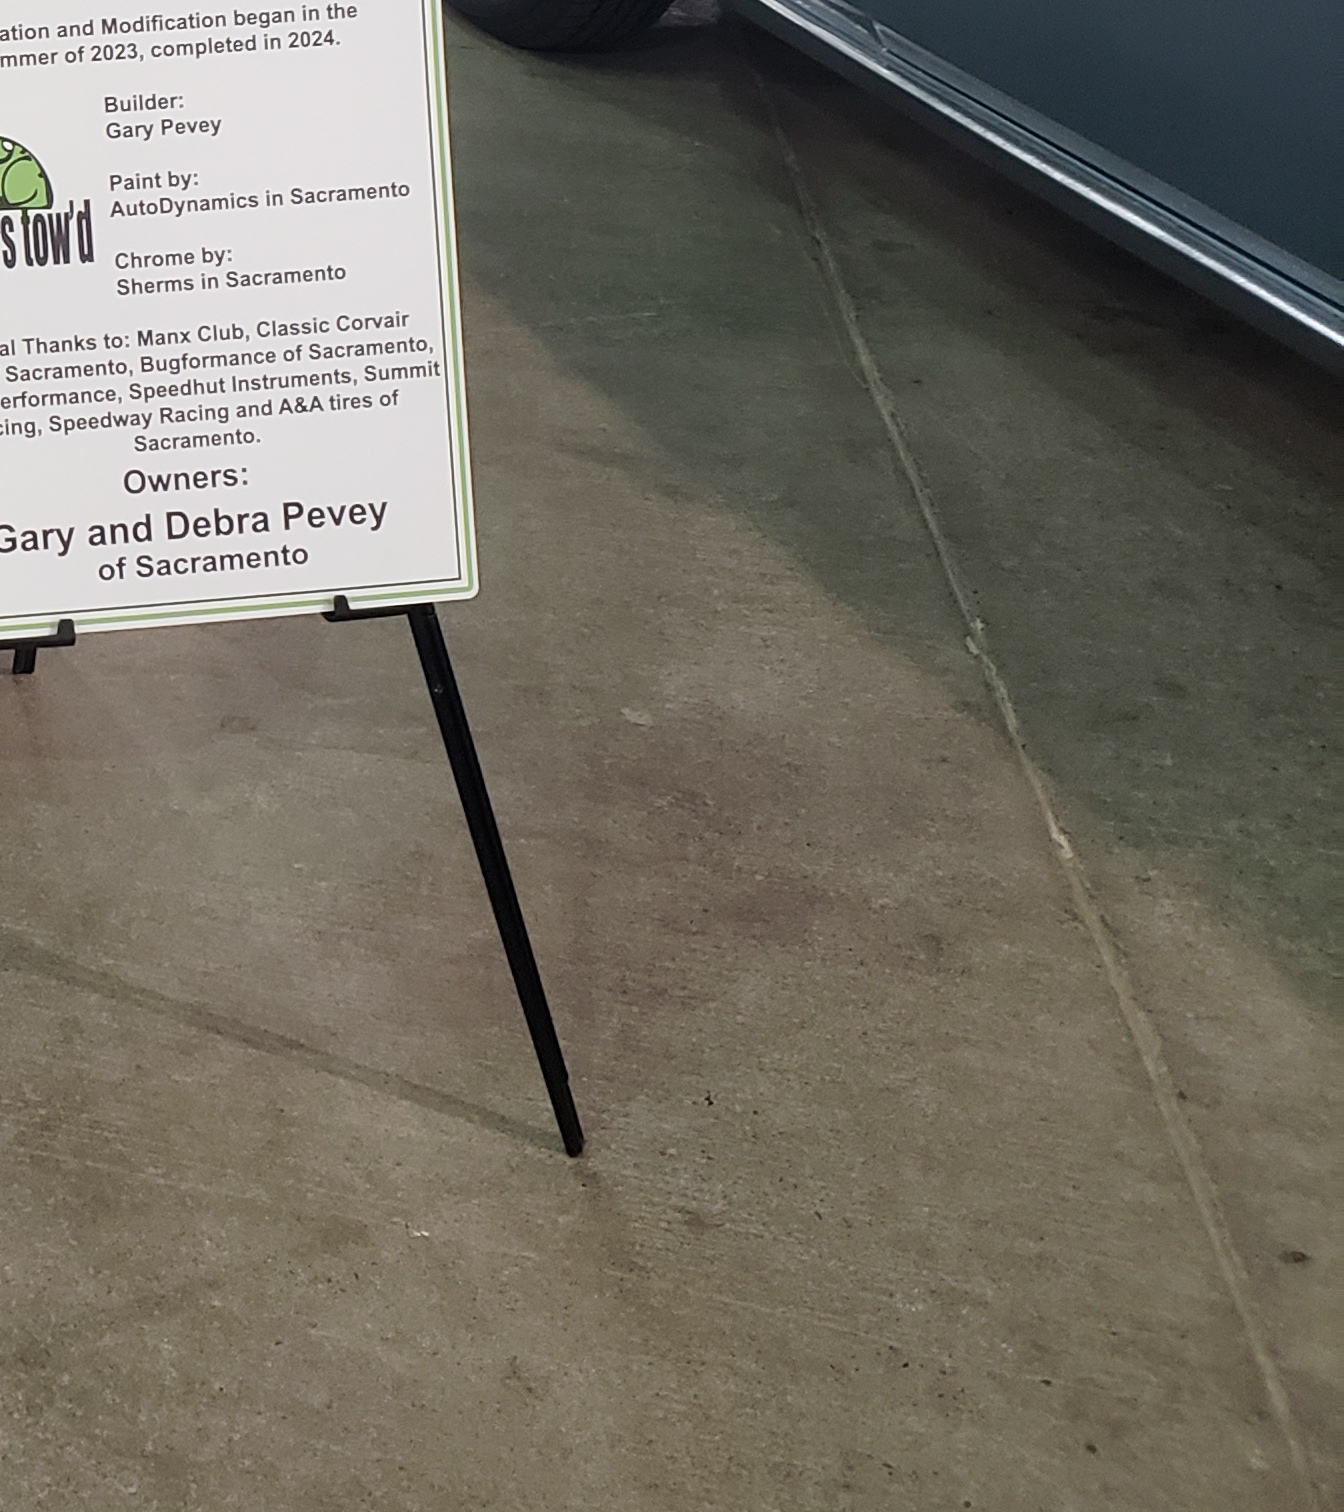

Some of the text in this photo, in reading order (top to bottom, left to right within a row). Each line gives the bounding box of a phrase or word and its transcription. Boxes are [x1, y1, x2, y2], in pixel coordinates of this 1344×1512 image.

[55, 18, 96, 39] and
[100, 10, 228, 36] Modification
[232, 8, 296, 29] began
[300, 3, 321, 23] in
[325, 1, 359, 21] the
[63, 44, 86, 65] of
[89, 41, 145, 63] 2023,
[149, 33, 258, 60] completed
[262, 32, 283, 51] in
[286, 28, 342, 50] 2024.
[103, 92, 185, 114] Builder:
[104, 117, 223, 143] Gary Pevey
[108, 169, 200, 193] Paint by:
[108, 180, 411, 219] AutoDynamics in Sacramento
[113, 246, 234, 271] Chrome by:
[115, 263, 347, 297] Sherms in Sacramento
[20, 333, 98, 356] Thanks
[101, 332, 131, 351] to:
[136, 328, 193, 348] Manx
[196, 322, 251, 343] Club,
[255, 316, 331, 339] Classic
[335, 309, 411, 333] Corvair
[4, 358, 134, 384] Sacramento,
[139, 349, 278, 377] Bugformance
[282, 343, 304, 363] of
[307, 335, 435, 361] Sacramento,
[128, 376, 227, 405] Speedhut
[230, 367, 359, 394] Instruments,
[363, 359, 442, 383] Summit
[48, 410, 154, 437] Speedway
[158, 403, 230, 425] Racing
[235, 398, 274, 420] and
[277, 394, 326, 416] A&A
[327, 392, 374, 412] tires
[378, 387, 400, 408] of
[133, 427, 262, 453] Sacramento.
[122, 466, 249, 496] Owners:
[87, 512, 154, 548] and
[164, 506, 272, 541] Debra
[281, 500, 389, 533] Pevey
[97, 543, 310, 582] of Sacramento
